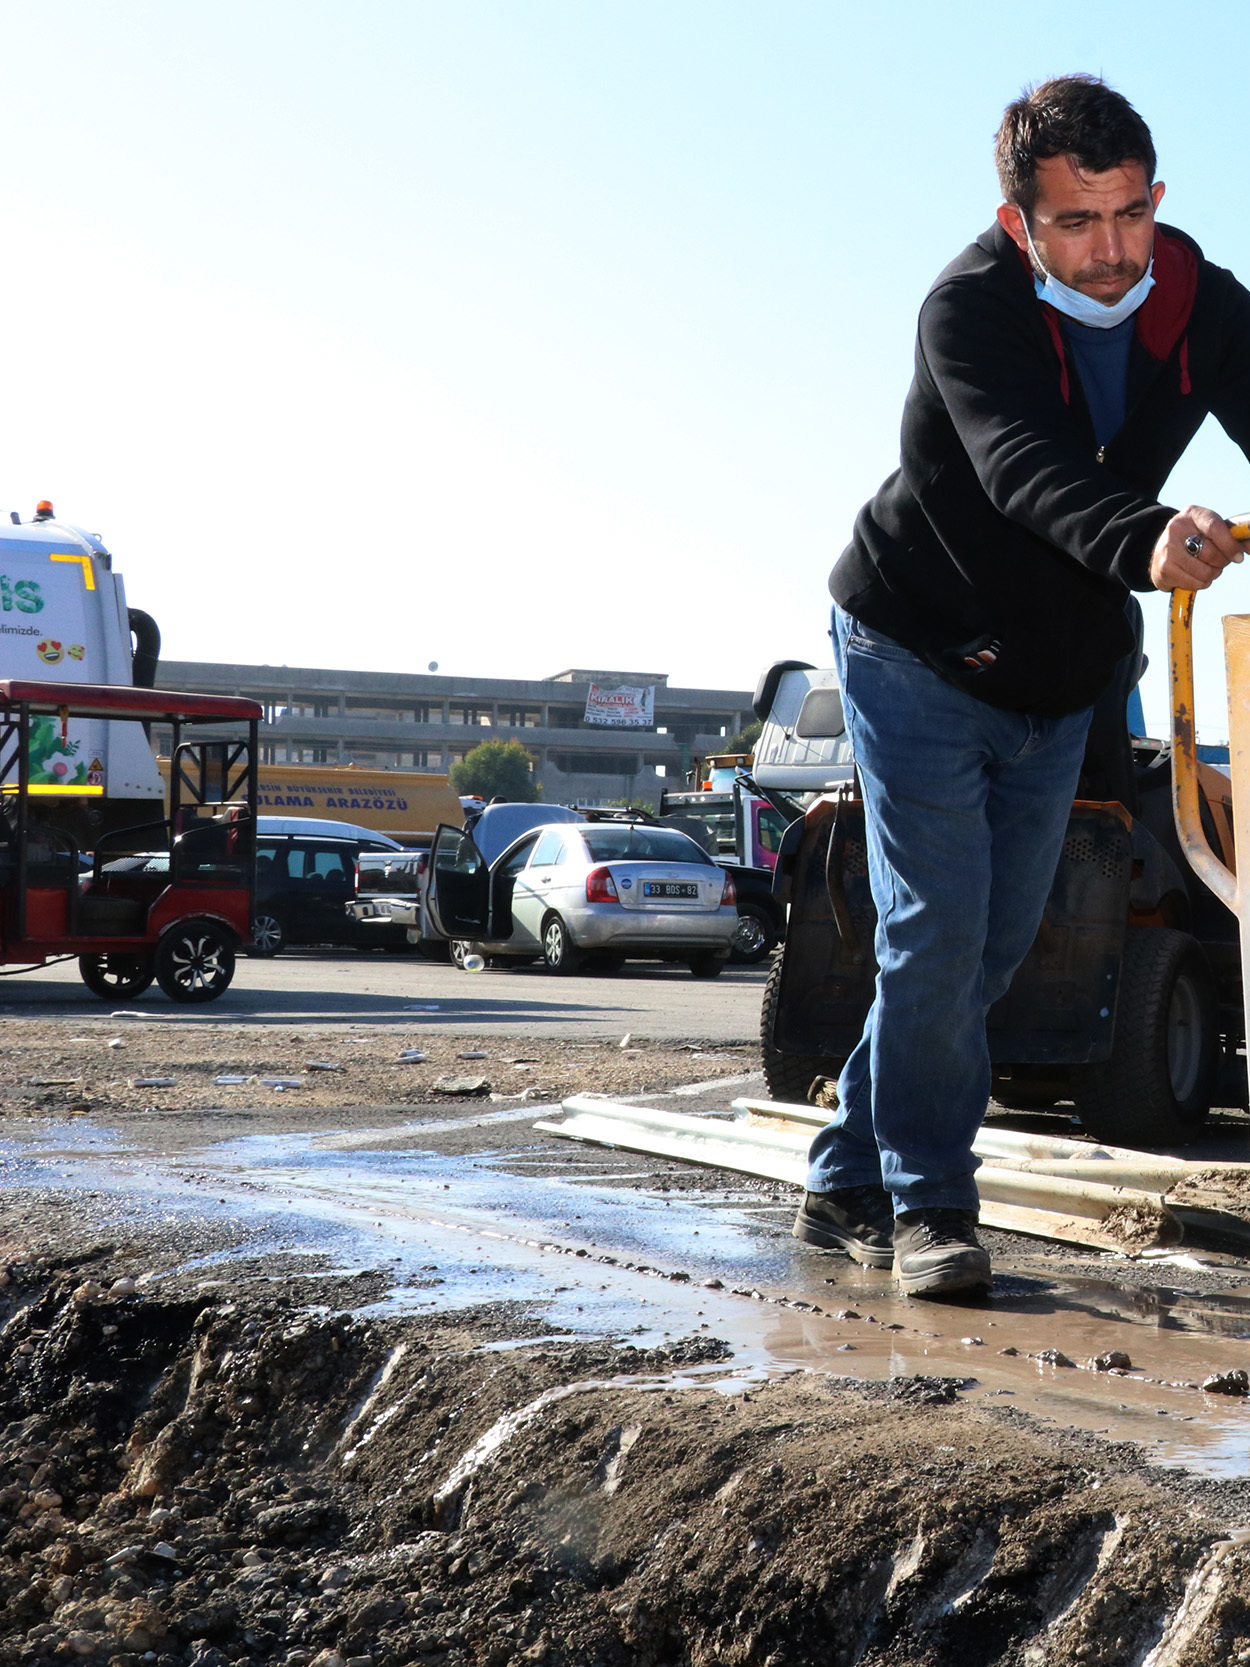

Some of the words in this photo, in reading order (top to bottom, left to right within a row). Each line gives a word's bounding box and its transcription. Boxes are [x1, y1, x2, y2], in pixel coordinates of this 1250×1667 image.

[326, 797, 408, 811] ARAZÖZÜ
[650, 884, 661, 894] 33
[686, 886, 697, 895] 82
